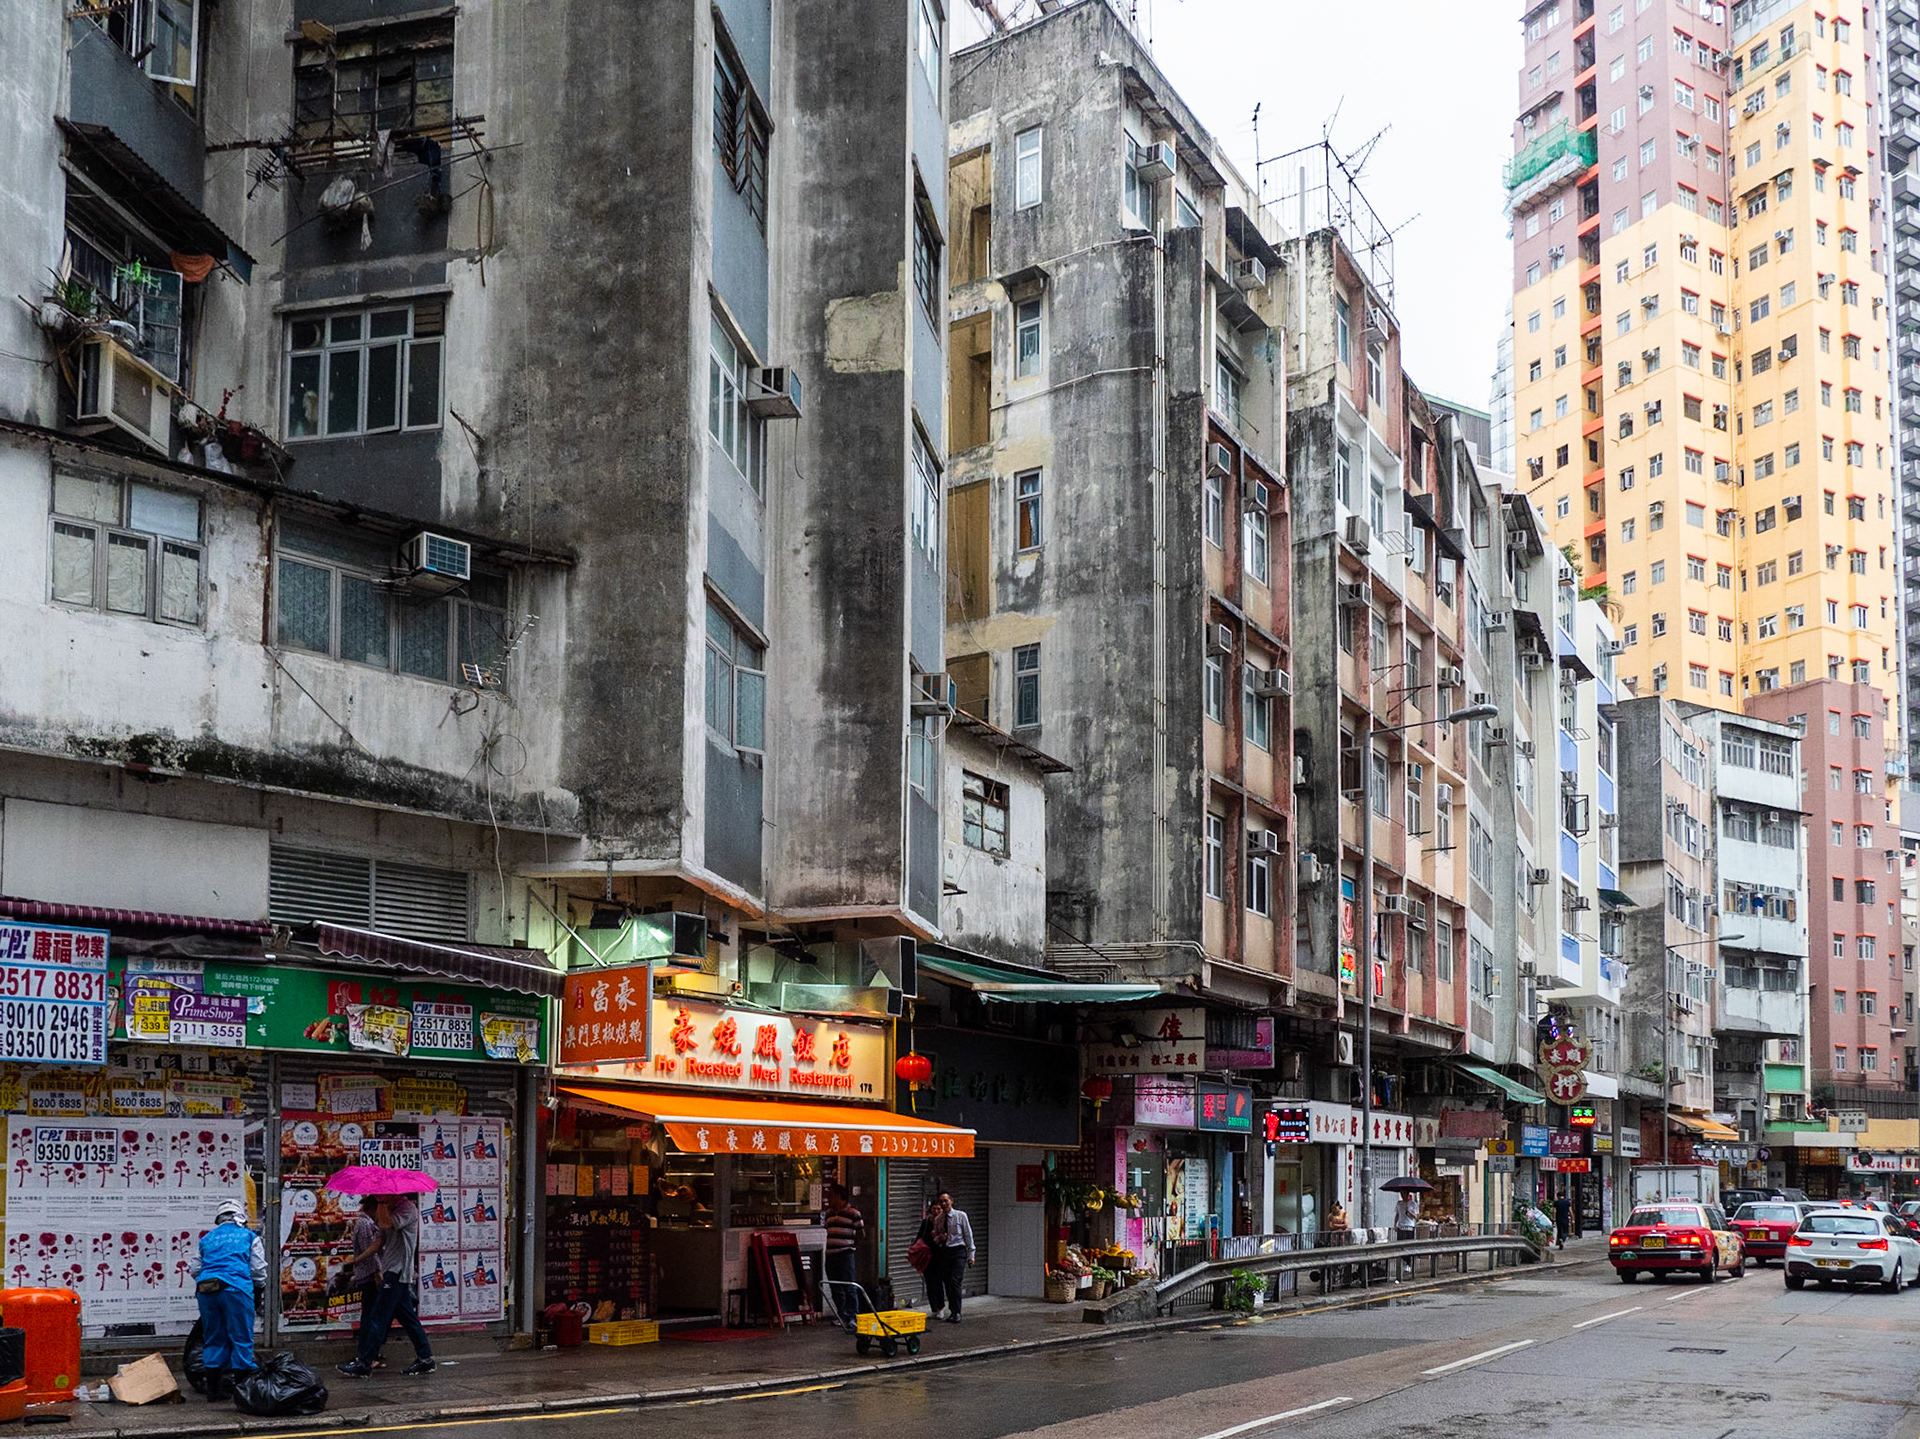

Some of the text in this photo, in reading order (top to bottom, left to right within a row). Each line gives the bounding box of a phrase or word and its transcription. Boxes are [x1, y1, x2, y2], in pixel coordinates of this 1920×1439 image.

[33, 930, 104, 964] 康福物業
[54, 971, 104, 1001] 8831
[590, 976, 637, 1012] 富豪
[6, 1002, 89, 1032] 9010 2946
[174, 994, 234, 1022] PrimeShop
[414, 1003, 433, 1015] CPI
[173, 1022, 243, 1038] 2111 3555
[420, 1019, 471, 1031] 2517 8831
[564, 1019, 642, 1049] 澳門黑椒燒鵝
[1158, 1013, 1184, 1047] 偉
[6, 1030, 89, 1060] 9350 0135
[414, 1031, 438, 1046] 9350
[442, 1033, 465, 1048] 0135
[656, 1053, 677, 1073] Ho
[686, 1056, 742, 1078] Roasted
[751, 1063, 783, 1082] Meat
[789, 1066, 856, 1088] Restaurant
[859, 1083, 873, 1094] 178
[1554, 1074, 1578, 1097] 押
[33, 1098, 82, 1109] 8200 6835
[114, 1097, 162, 1108] 8200 6835
[38, 1129, 64, 1142] CPI
[881, 1135, 956, 1154] 23922918
[37, 1143, 70, 1161] 9350
[74, 1144, 106, 1161] 0135
[362, 1140, 381, 1151] CPI
[361, 1153, 387, 1168] 9350
[390, 1153, 414, 1169] 0135
[328, 1295, 346, 1307] COME
